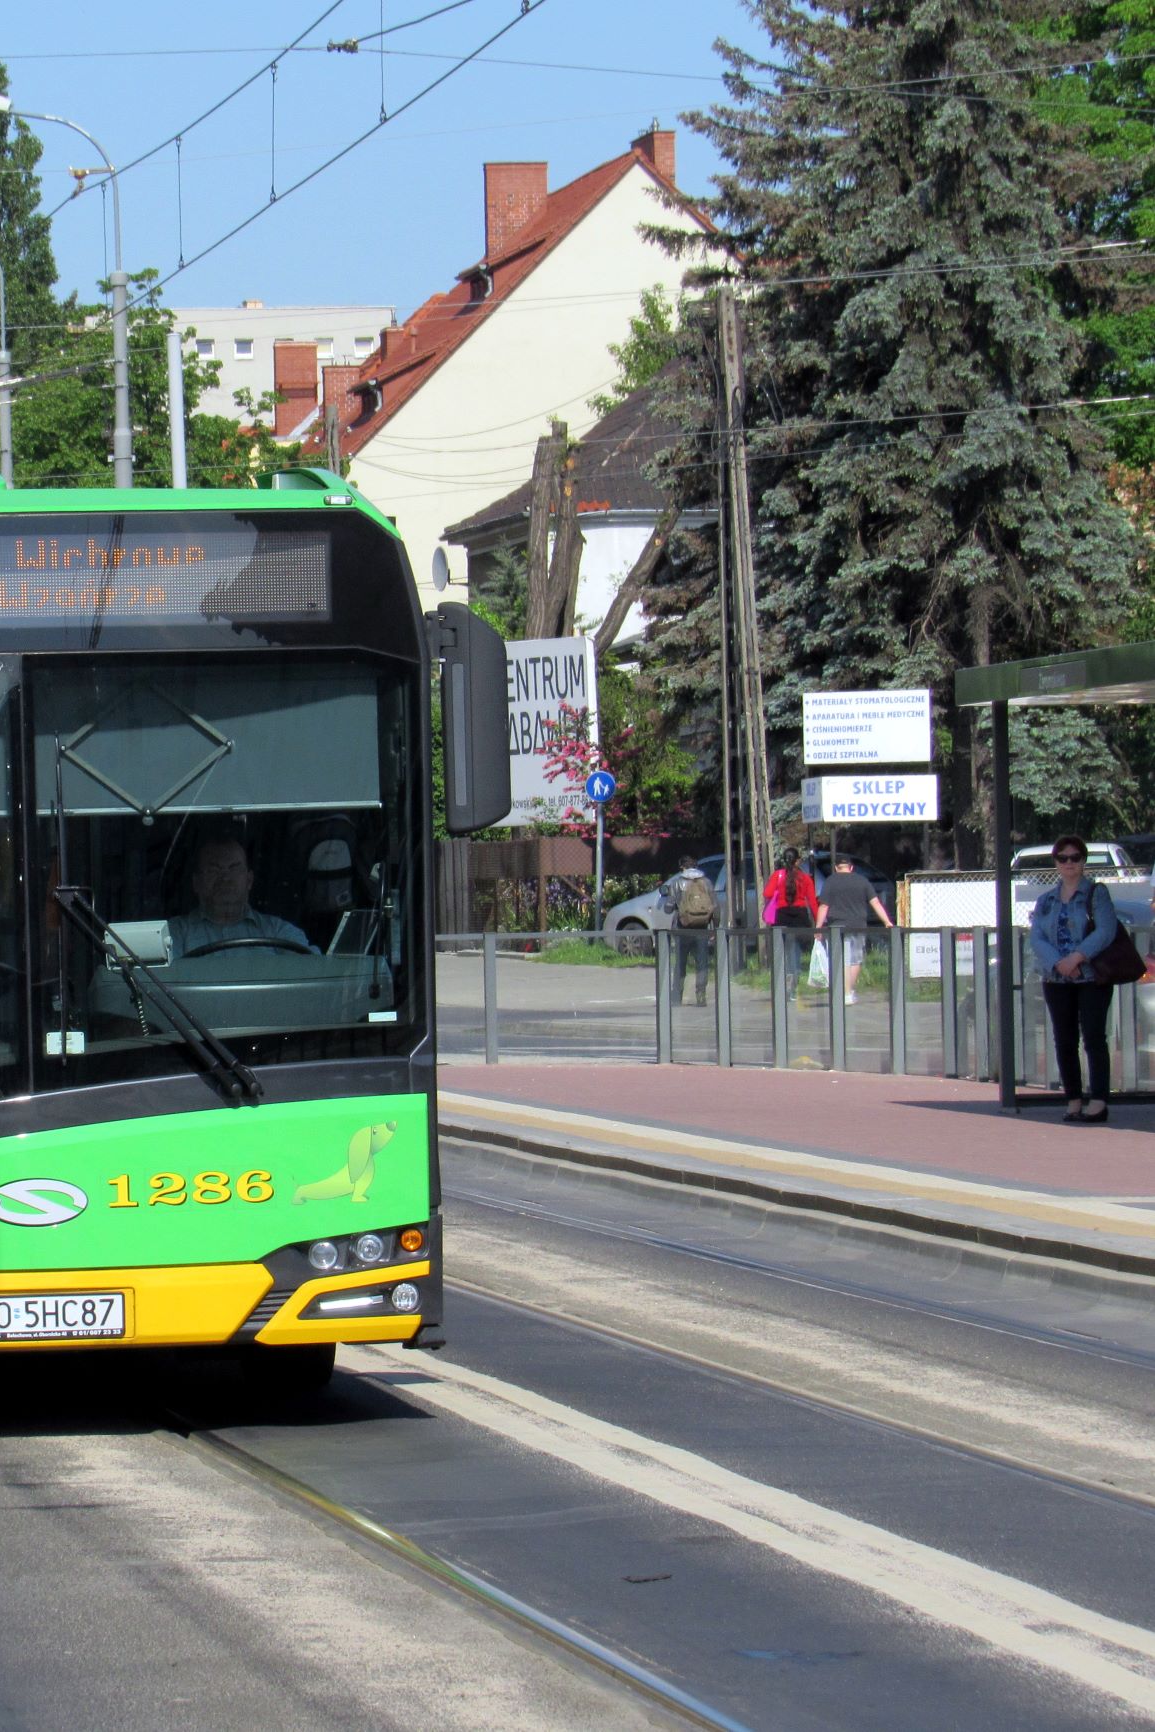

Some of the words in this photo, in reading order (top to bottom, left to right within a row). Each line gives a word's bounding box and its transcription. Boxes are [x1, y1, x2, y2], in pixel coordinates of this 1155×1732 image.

[506, 653, 586, 702] ENTRUM
[855, 696, 925, 705] STOMATOLOGICZNE
[812, 712, 855, 720] APARATURA
[887, 710, 925, 718] MEDYCZNE
[812, 738, 860, 746] GLUKOMETRY
[840, 750, 879, 759] SZPITALNA
[852, 780, 905, 795] SKLEP
[832, 802, 926, 817] MEDYCZNY
[107, 1169, 274, 1209] 1286
[24, 1298, 115, 1329] 5HC87
